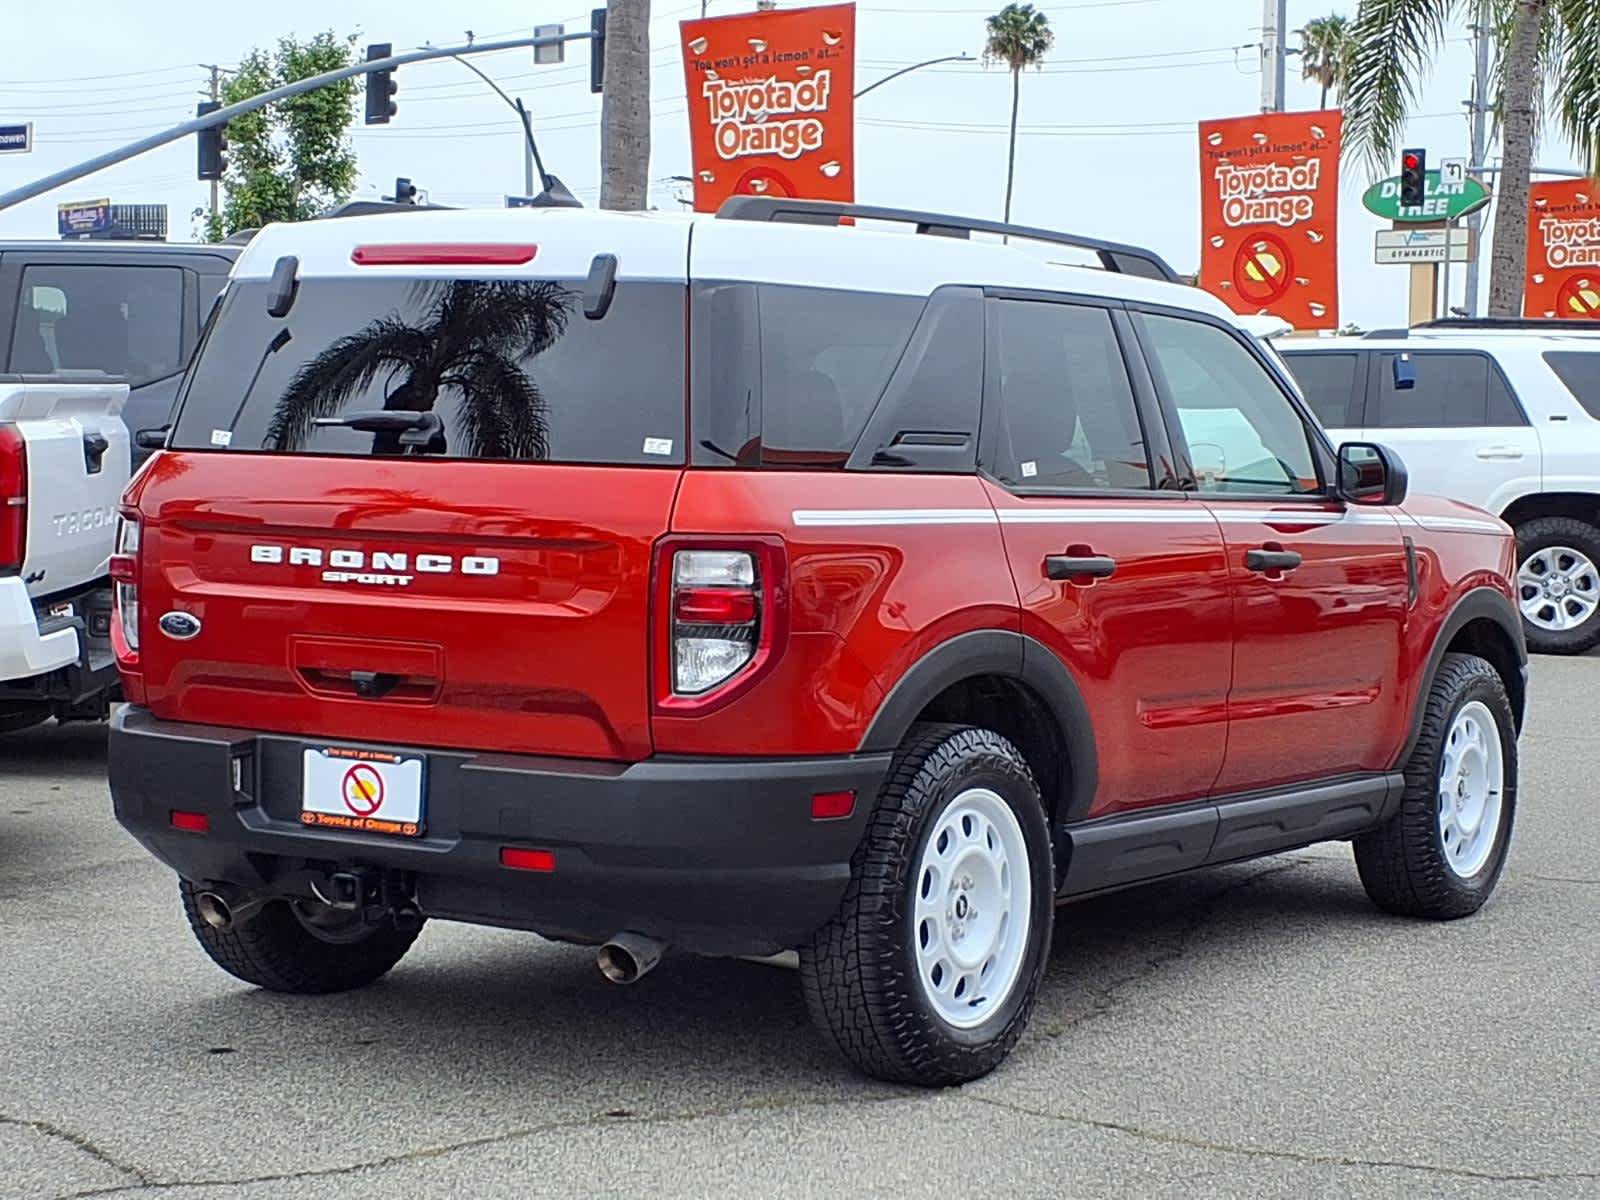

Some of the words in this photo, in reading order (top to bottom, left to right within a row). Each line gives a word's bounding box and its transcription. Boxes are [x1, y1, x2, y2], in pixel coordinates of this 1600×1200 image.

[743, 54, 760, 68] get
[762, 53, 770, 63] a
[703, 76, 796, 123] Toyota
[796, 70, 831, 112] of
[716, 118, 823, 159] Orange
[1215, 163, 1291, 199] Toyota
[1291, 158, 1320, 190] of
[1381, 179, 1465, 198] DLAR
[1223, 195, 1313, 226] Orange
[53, 506, 120, 537] TACOM
[250, 545, 499, 575] BRONCO
[321, 571, 414, 585] SPORT
[317, 813, 351, 827] Toyota
[352, 818, 364, 827] of
